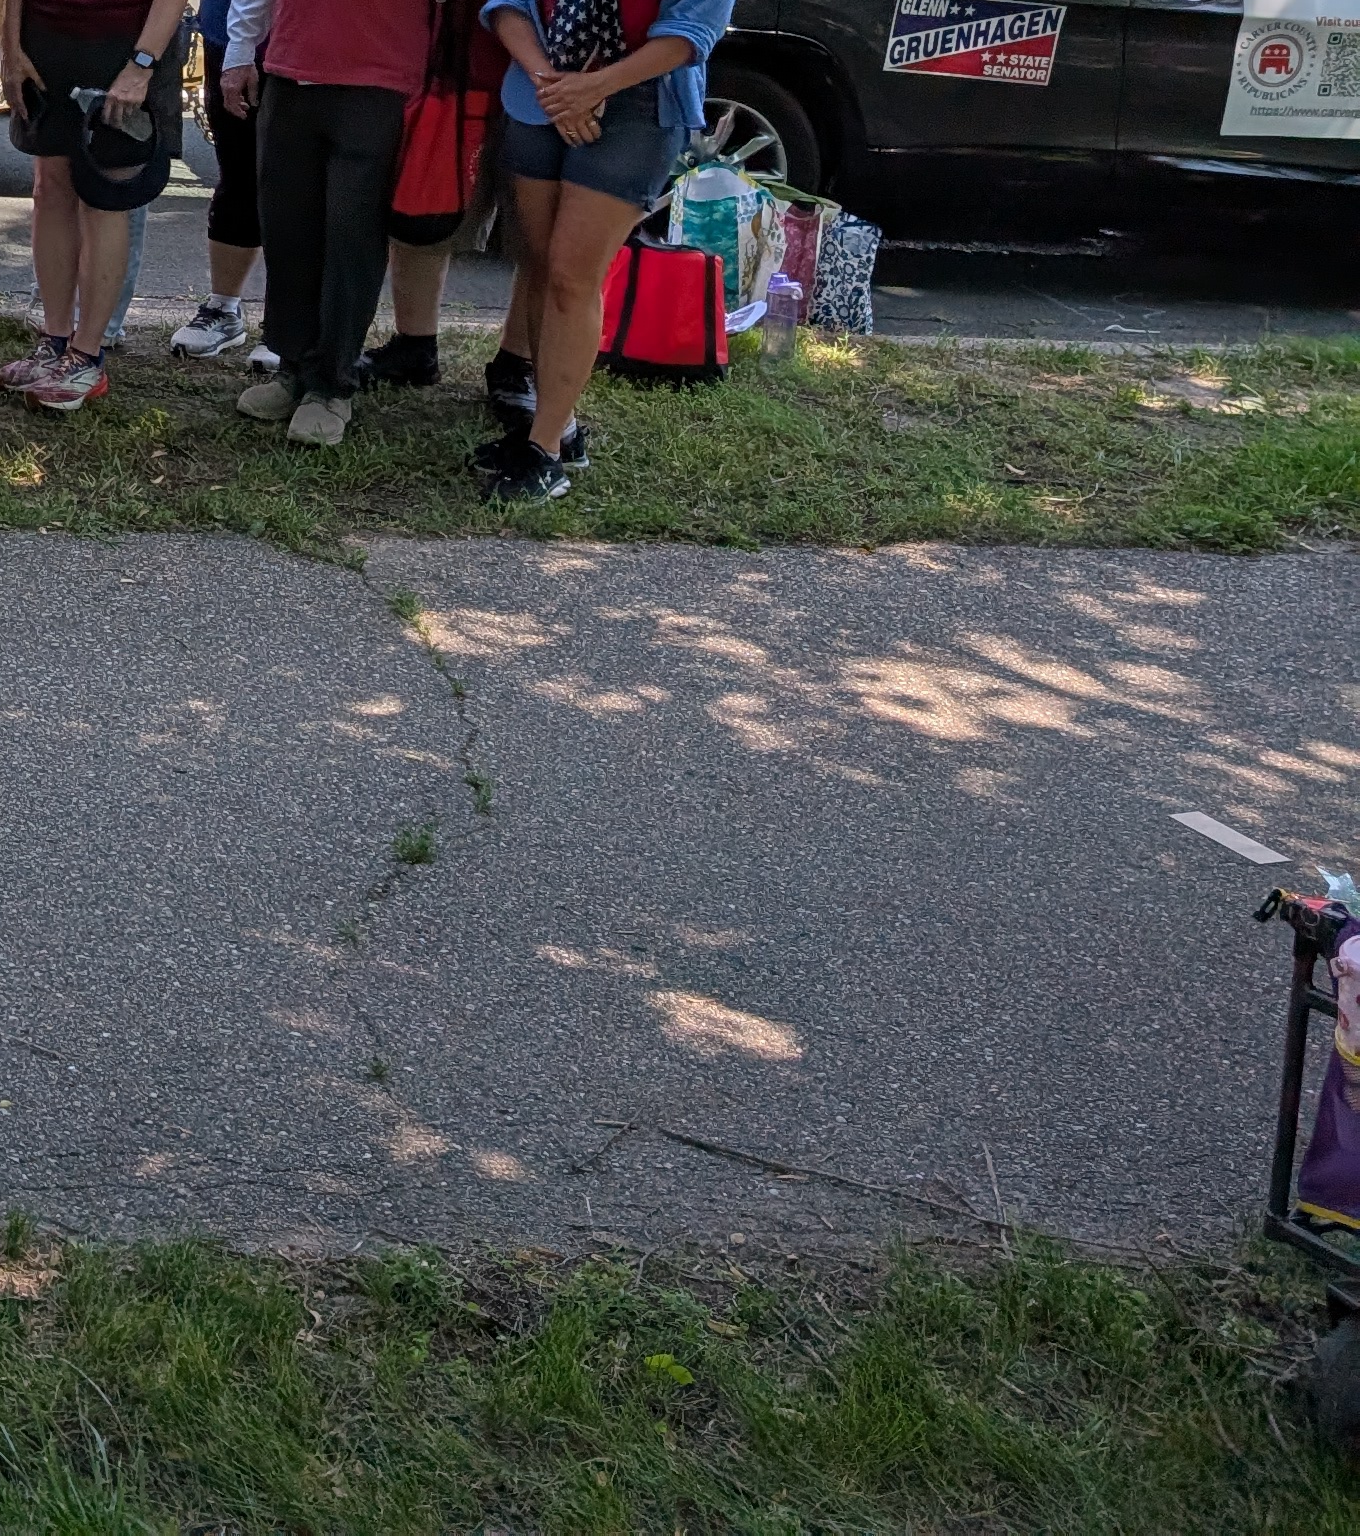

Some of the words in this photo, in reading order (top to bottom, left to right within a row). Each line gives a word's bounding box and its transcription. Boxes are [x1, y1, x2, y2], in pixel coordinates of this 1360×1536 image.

[1316, 16, 1342, 27] Visit
[889, 7, 1062, 65] GRUENHAGEN
[1240, 21, 1282, 50] CARVER
[1283, 21, 1318, 52] COUNTY
[1008, 54, 1051, 69] STATE
[982, 65, 1048, 82] SENATOR
[1237, 75, 1309, 102] REPUBLICANS
